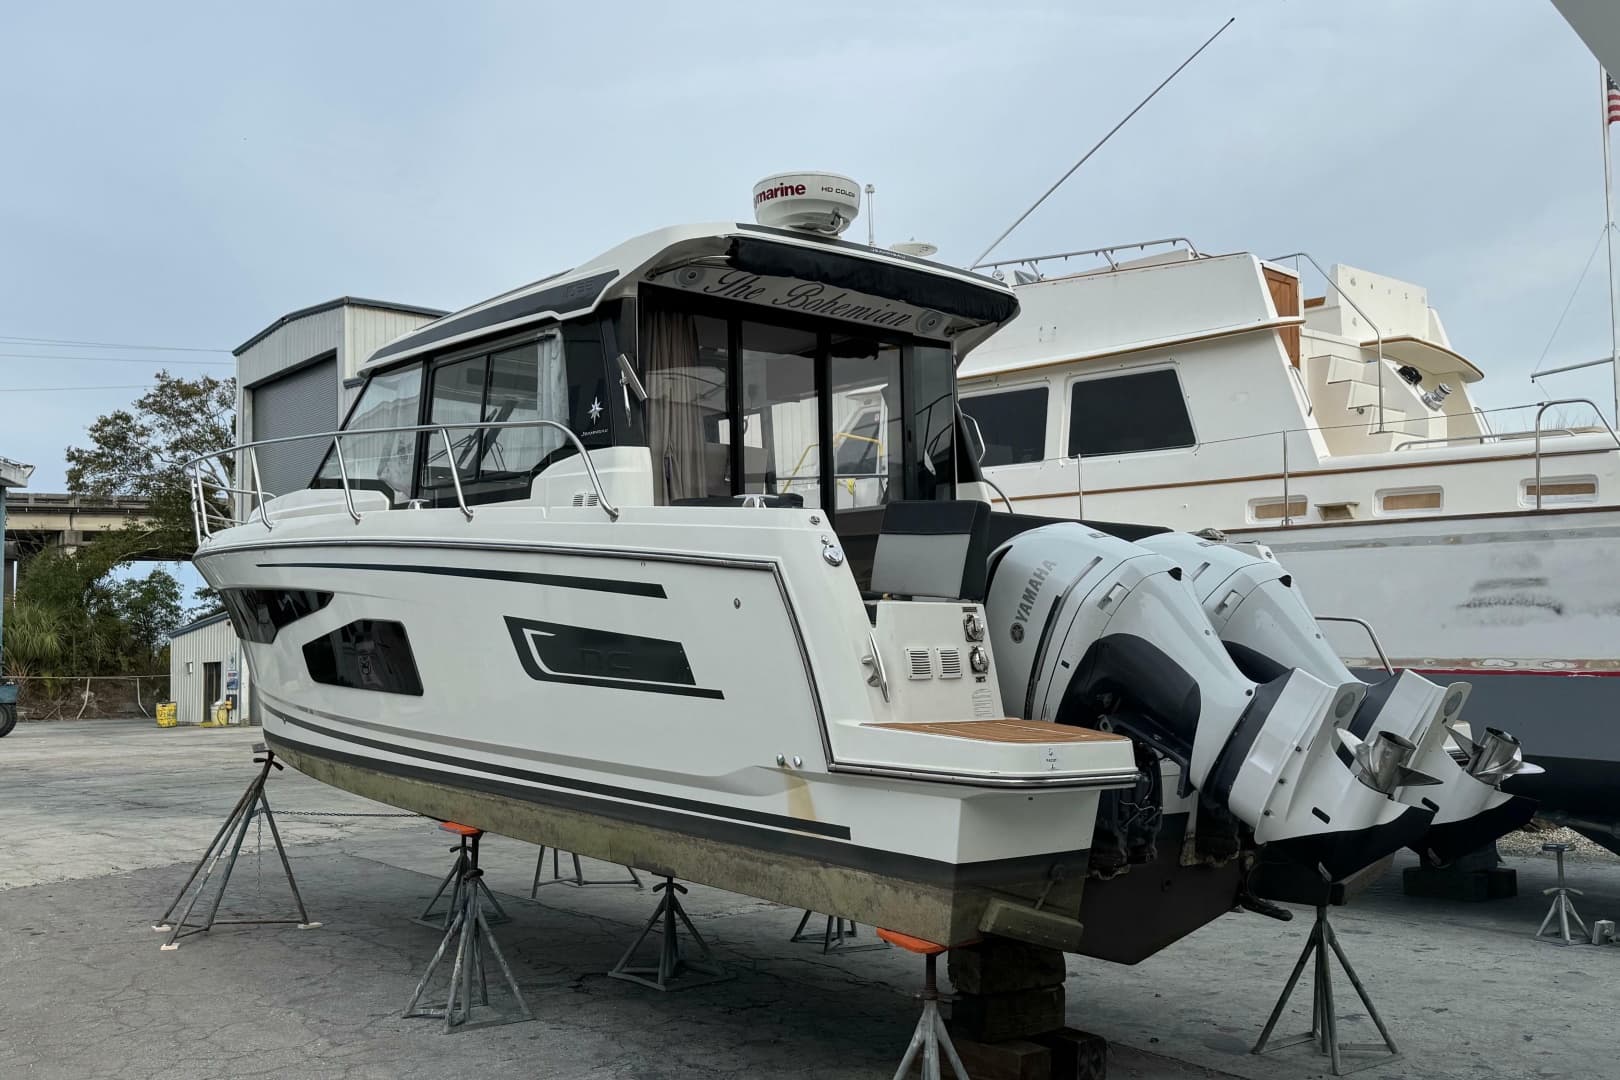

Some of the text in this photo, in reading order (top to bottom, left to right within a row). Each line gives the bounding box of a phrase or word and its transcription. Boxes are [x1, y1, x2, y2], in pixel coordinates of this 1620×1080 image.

[821, 185, 834, 193] HD
[703, 270, 913, 327] The Bohemian
[1014, 560, 1057, 623] YAMAHA
